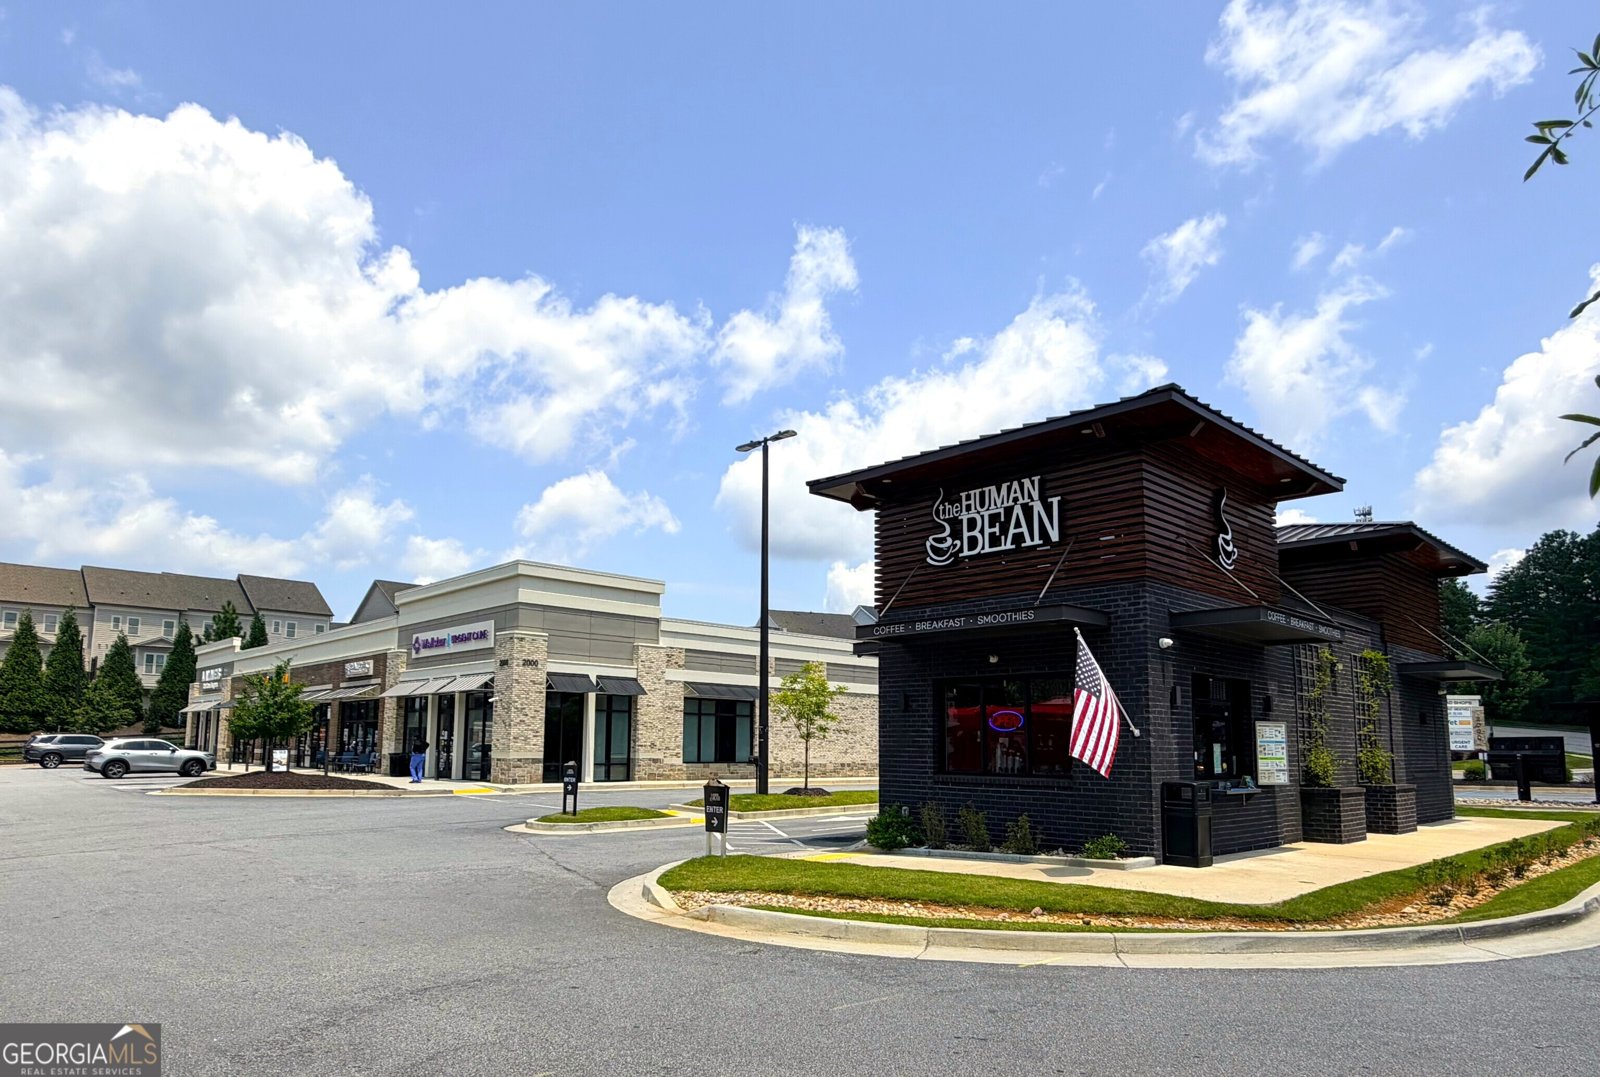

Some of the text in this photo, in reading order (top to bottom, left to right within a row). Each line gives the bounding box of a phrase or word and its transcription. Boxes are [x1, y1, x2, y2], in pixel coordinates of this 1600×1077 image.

[939, 475, 1041, 520] the HUMAN
[958, 496, 1062, 557] BEAN
[873, 610, 1035, 636] COFFEE BREAKFAST SMOOTHIES
[1268, 610, 1286, 624] COFFEE
[1290, 616, 1314, 630] BREAKFAST
[522, 659, 539, 668] 2000
[706, 805, 724, 814] ENTER
